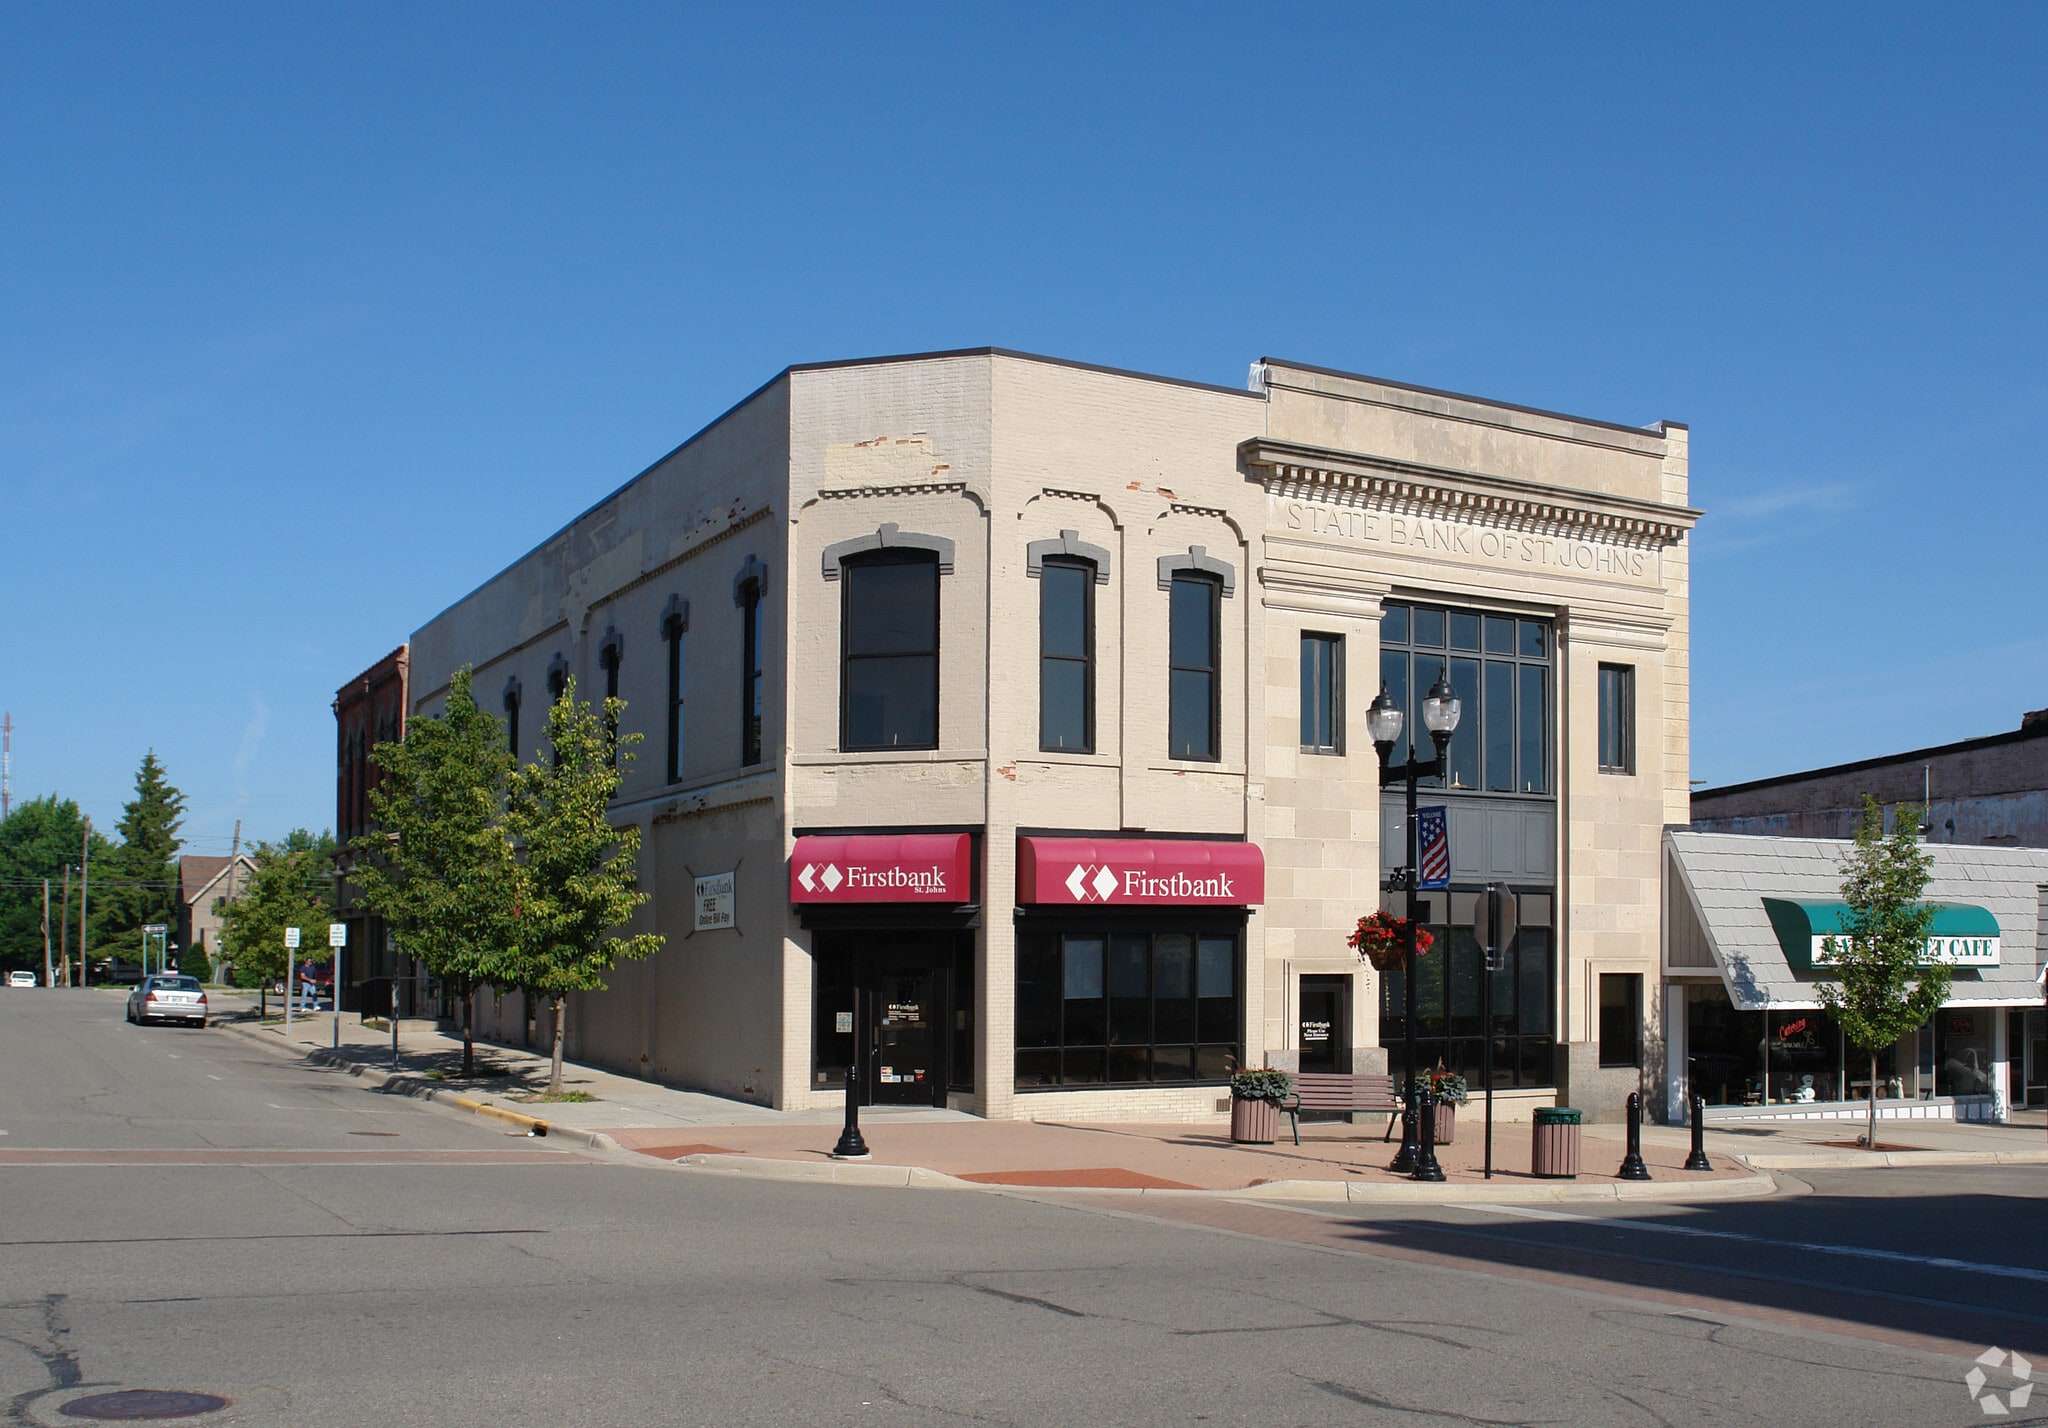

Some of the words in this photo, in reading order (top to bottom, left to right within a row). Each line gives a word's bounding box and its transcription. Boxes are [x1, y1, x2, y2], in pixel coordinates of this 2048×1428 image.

[1287, 503, 1380, 542] STATE
[1390, 517, 1470, 554] BANK
[1480, 532, 1518, 558] OF
[1520, 537, 1557, 566] ST.
[1559, 543, 1645, 577] JOHNS
[846, 866, 946, 887] Firstbank
[1122, 870, 1235, 898] Firstbank
[704, 879, 733, 897] Firstbank
[914, 886, 925, 894] St.
[925, 886, 947, 894] Johns
[703, 897, 717, 912] FREE
[1949, 938, 1993, 957] CAFE
[1779, 1017, 1806, 1041] Catering
